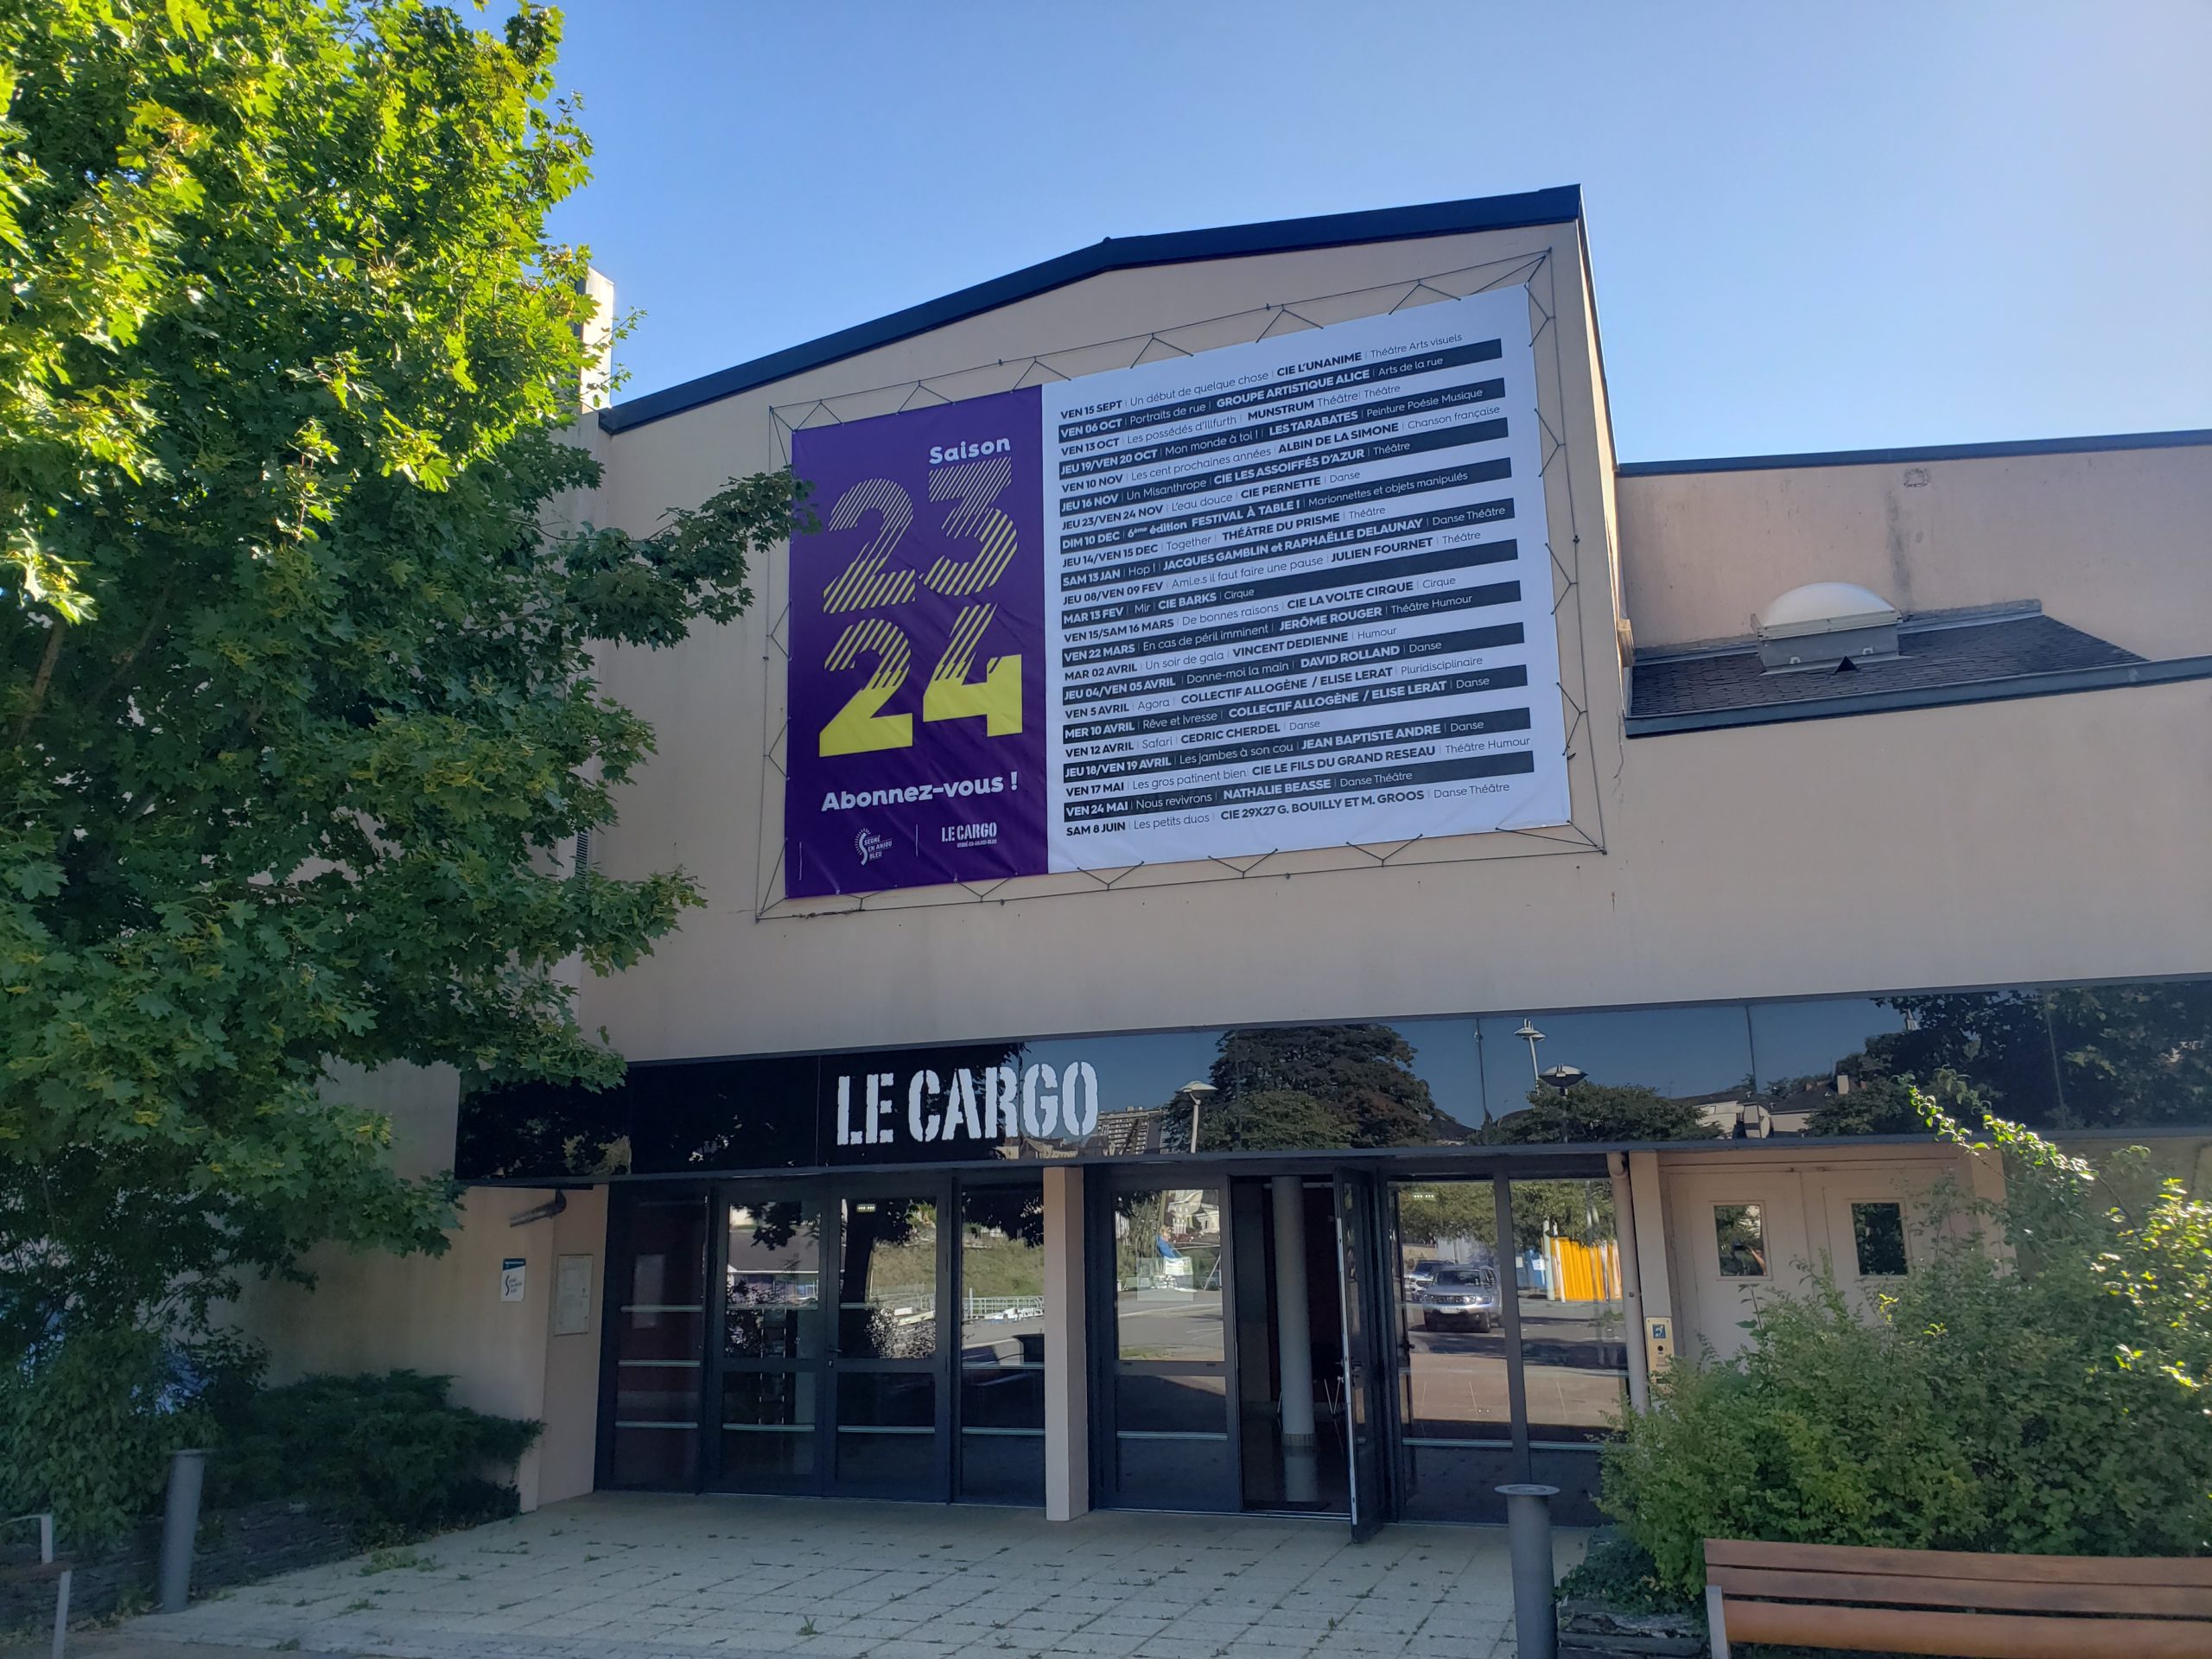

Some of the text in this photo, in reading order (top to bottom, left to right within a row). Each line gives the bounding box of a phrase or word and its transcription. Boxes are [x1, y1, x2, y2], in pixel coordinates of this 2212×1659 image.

[1096, 334, 1463, 413] SEPT début quelque chose Arts visuels
[1129, 365, 1398, 426] Portraits GROUPE ARTISTIQUE ALICE Arts
[1080, 389, 1484, 472] 19/VEN monde TARABATES Peinture Poésie Musique
[1145, 392, 1358, 442] possédés MUNSTRUM Théâtre
[1149, 406, 1501, 478] cent prochaines années ALBIN SIMONE Chanson française
[929, 436, 1011, 465] Saison
[1143, 442, 1411, 499] Misanthrope ASSOIFFÉS Théâtre
[1081, 472, 1361, 528] 23/VEN douce PERNETTE Danse
[1149, 472, 1469, 535] édition FESTIVAL TABLE Marionnettes objets manipulés
[823, 456, 1018, 614] 23
[1083, 506, 1386, 565] 14/VEN Together THÉÂTRE PRISME Théâtre
[1162, 507, 1506, 571] JACQUES GAMBLIN RAPHAËLLE DELAUNAY Danse Théâtre
[1084, 531, 1481, 602] 08/VEN Ami.e.s faut faire pause JULIEN FOURNET Théâtre
[1088, 577, 1456, 640] 15/SAM MARS bonnes raisons VOLTE CIRQUE Cirque
[1178, 588, 1255, 607] BARKS Cirque
[1103, 595, 1473, 658] MARS péril imminent JERÔME ROUGER Théâtre Humour
[1105, 627, 1397, 676] AVRIL soir gala VINCENT DEDIENNE Humour
[819, 602, 1023, 758] 24
[1085, 642, 1442, 698] 04/VEN AVRIL Donne-moi main DAVID ROLLAND Danse
[1097, 657, 1484, 715] AVRIL Agora COLLECTIF ALLOGÈNE ELISE LERAT Pluridisciplinaire
[1103, 677, 1491, 734] AVRIL Rêve ivresse COLLECTIF ALLOGÈNE ELISE LERAT Danse
[1085, 721, 1484, 776] 18/VEN AVRIL jambes JEAN BAPTISTE ANDRE Danse
[1102, 721, 1321, 754] AVRIL Safari CEDRIC CHERDEL Danse
[1151, 737, 1530, 791] gros patinent bien FILS GRAND RESEAU Théâtre Humour
[821, 771, 1018, 812] Abonnez-vous !
[1101, 783, 1510, 833] JUIN petits duos 29X27 BOUILLY GROOS Danse Théâtre
[1135, 772, 1413, 810] Nous revivrons NATHALIE BEASSE Danse Théâtre
[942, 822, 997, 842] LE CARGO
[836, 1061, 1098, 1146] LE CARGO
